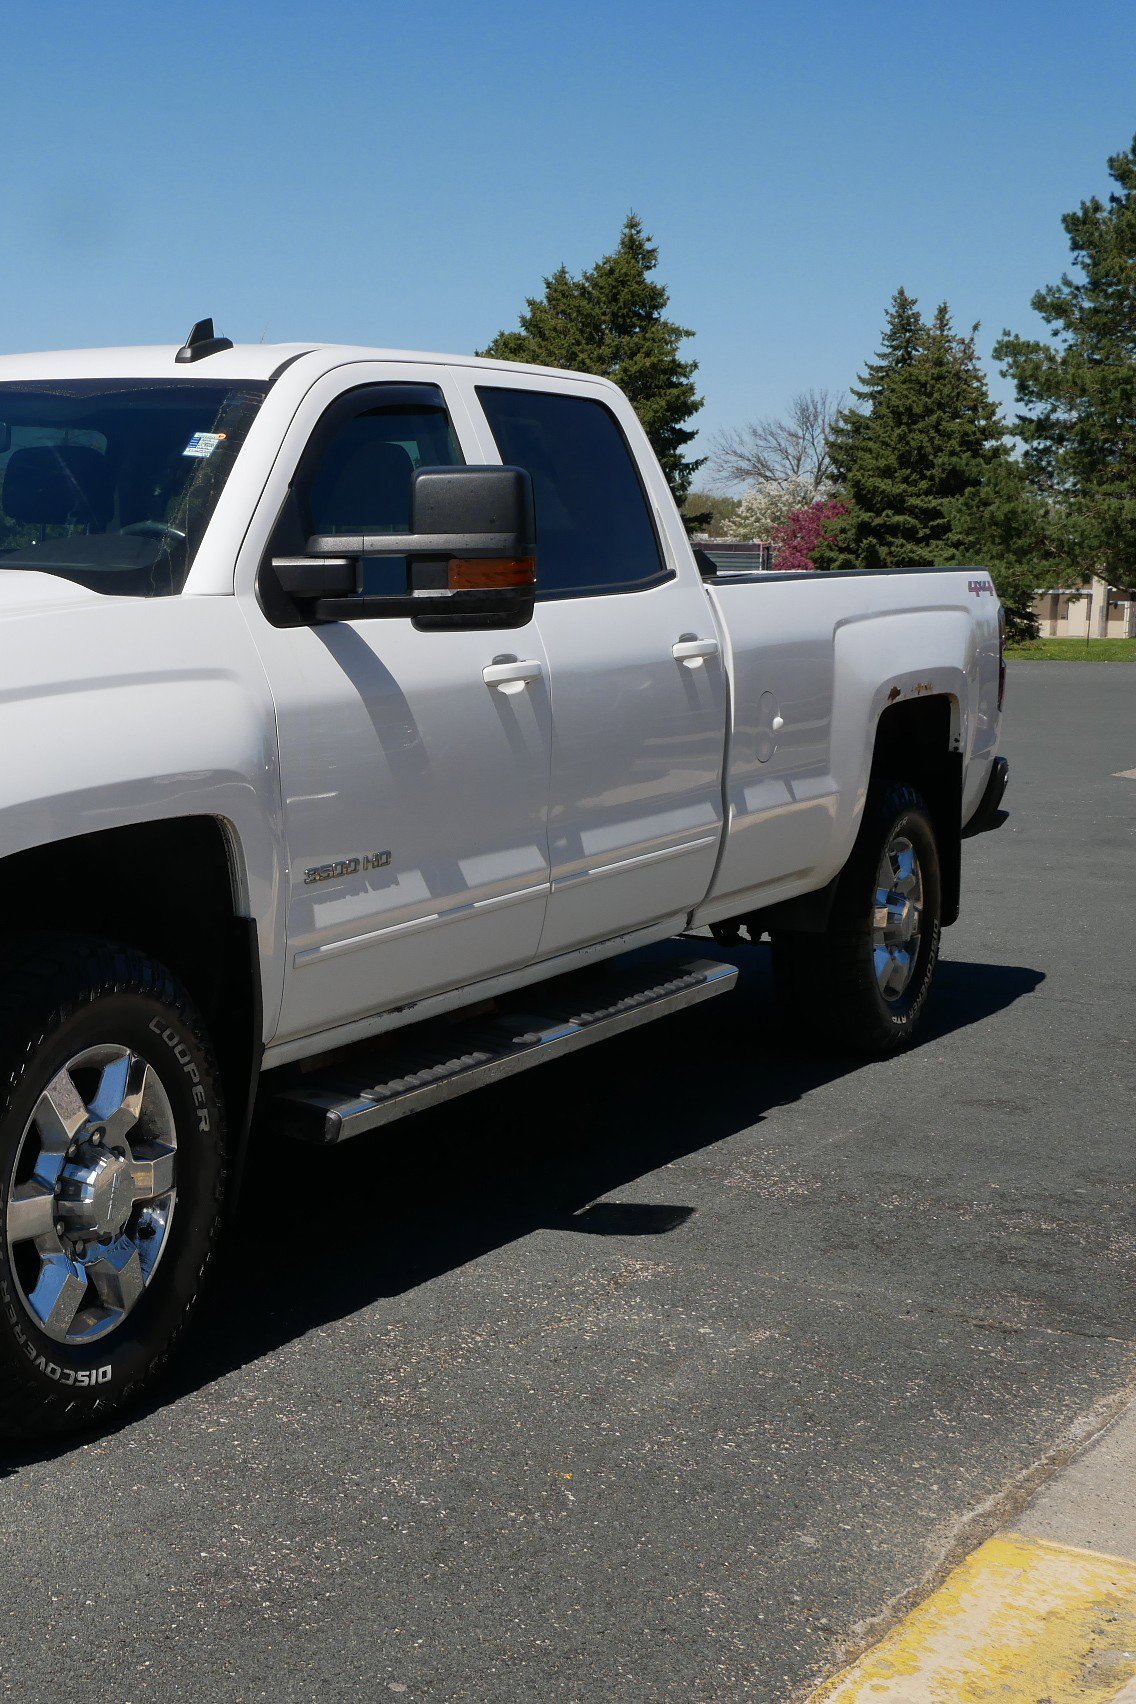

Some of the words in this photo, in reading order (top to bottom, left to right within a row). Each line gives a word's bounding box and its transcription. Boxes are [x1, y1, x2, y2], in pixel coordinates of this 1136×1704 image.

[363, 849, 392, 871] HD
[148, 1015, 211, 1133] COOPER
[0, 1279, 113, 1387] DISCOVERER
